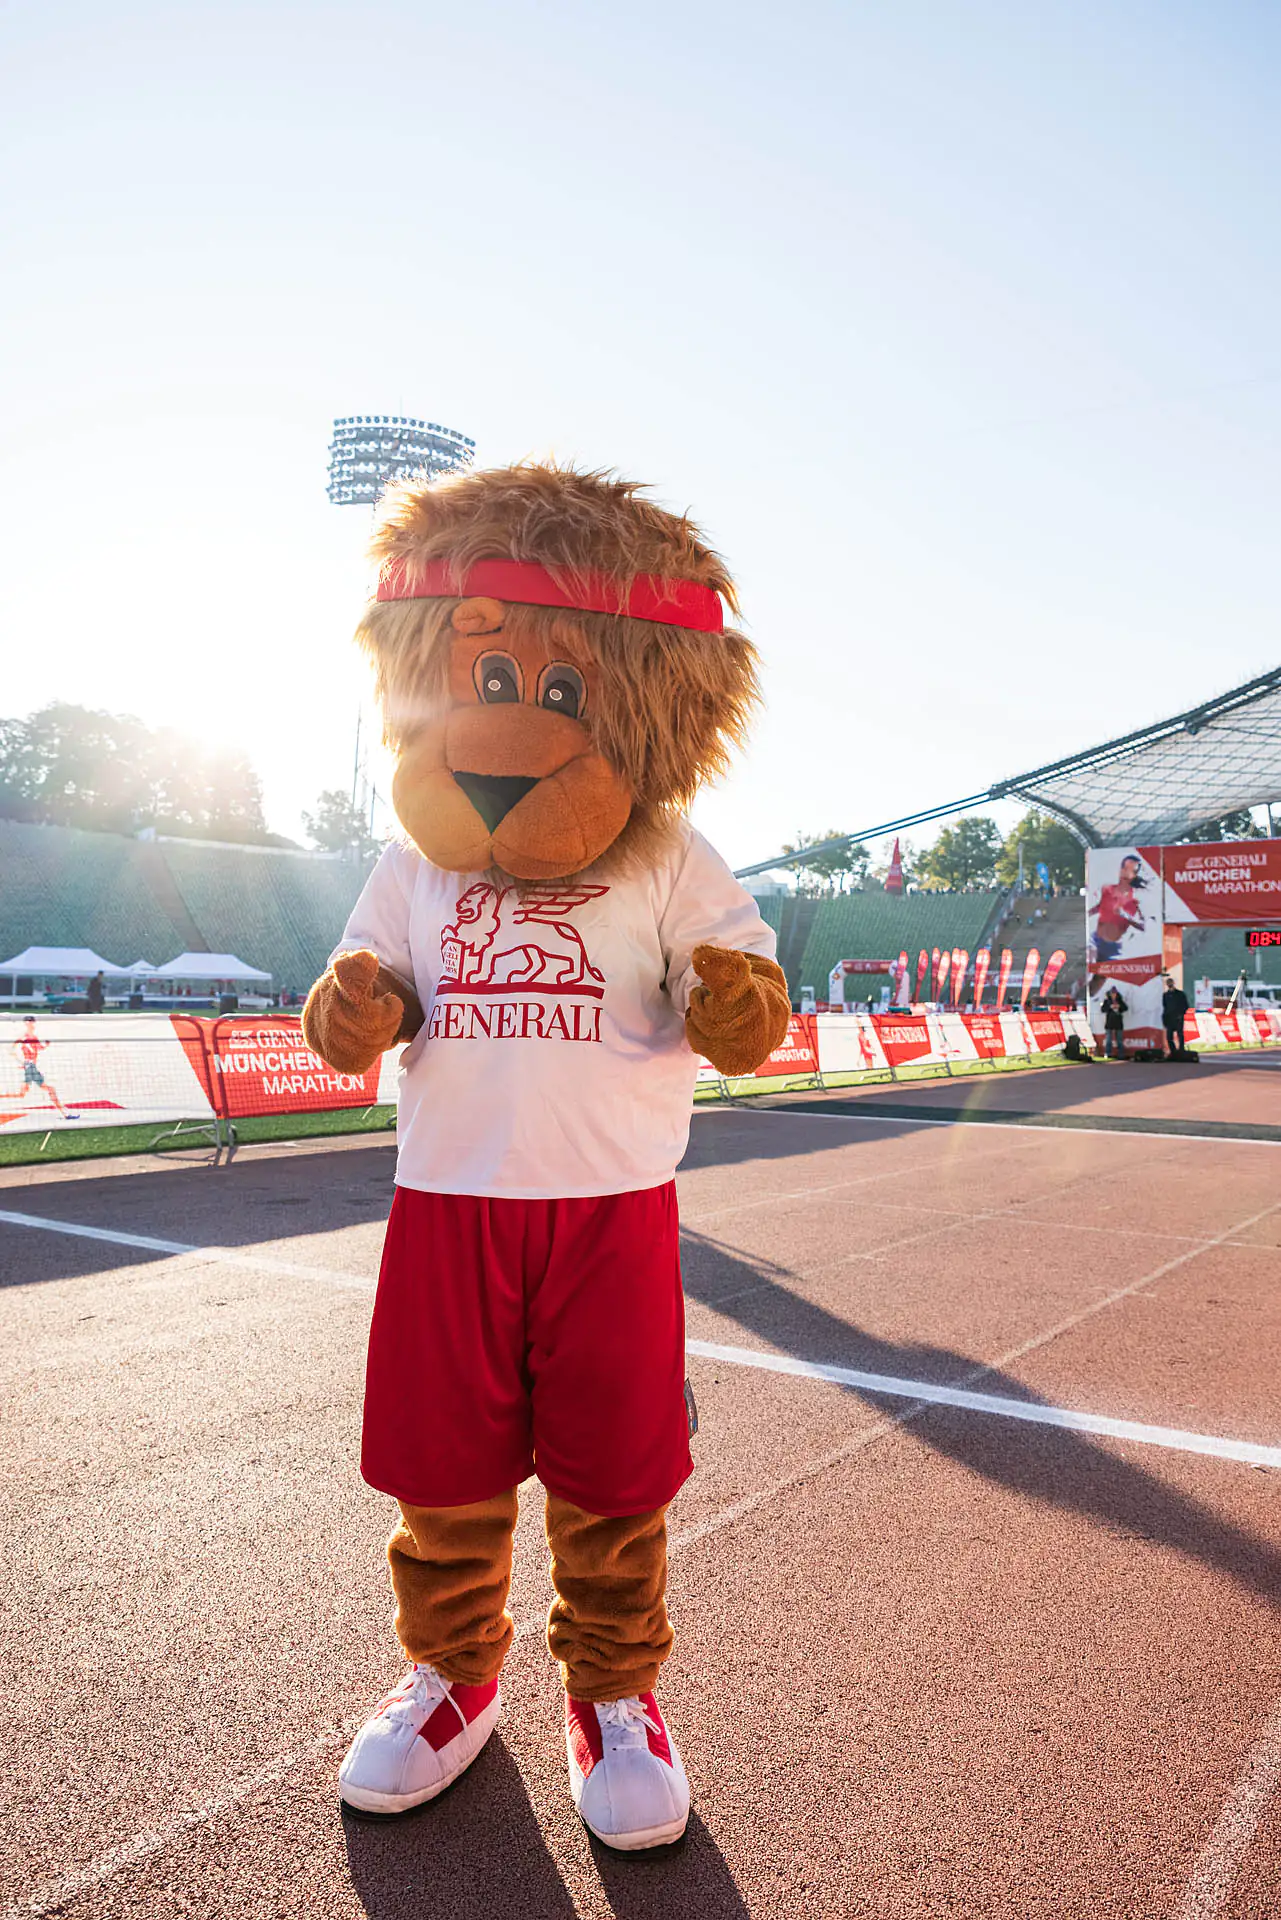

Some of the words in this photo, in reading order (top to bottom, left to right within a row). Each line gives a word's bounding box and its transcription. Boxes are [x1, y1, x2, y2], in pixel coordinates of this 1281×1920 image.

[1204, 853, 1267, 867] GENERALI
[1174, 868, 1251, 883] MÜNCHEN
[1204, 880, 1281, 893] MARATHON
[428, 1002, 604, 1042] GENERALI
[256, 1029, 307, 1048] GENE
[213, 1052, 323, 1073] MÜNCHEN
[262, 1074, 365, 1095] MARATHON
